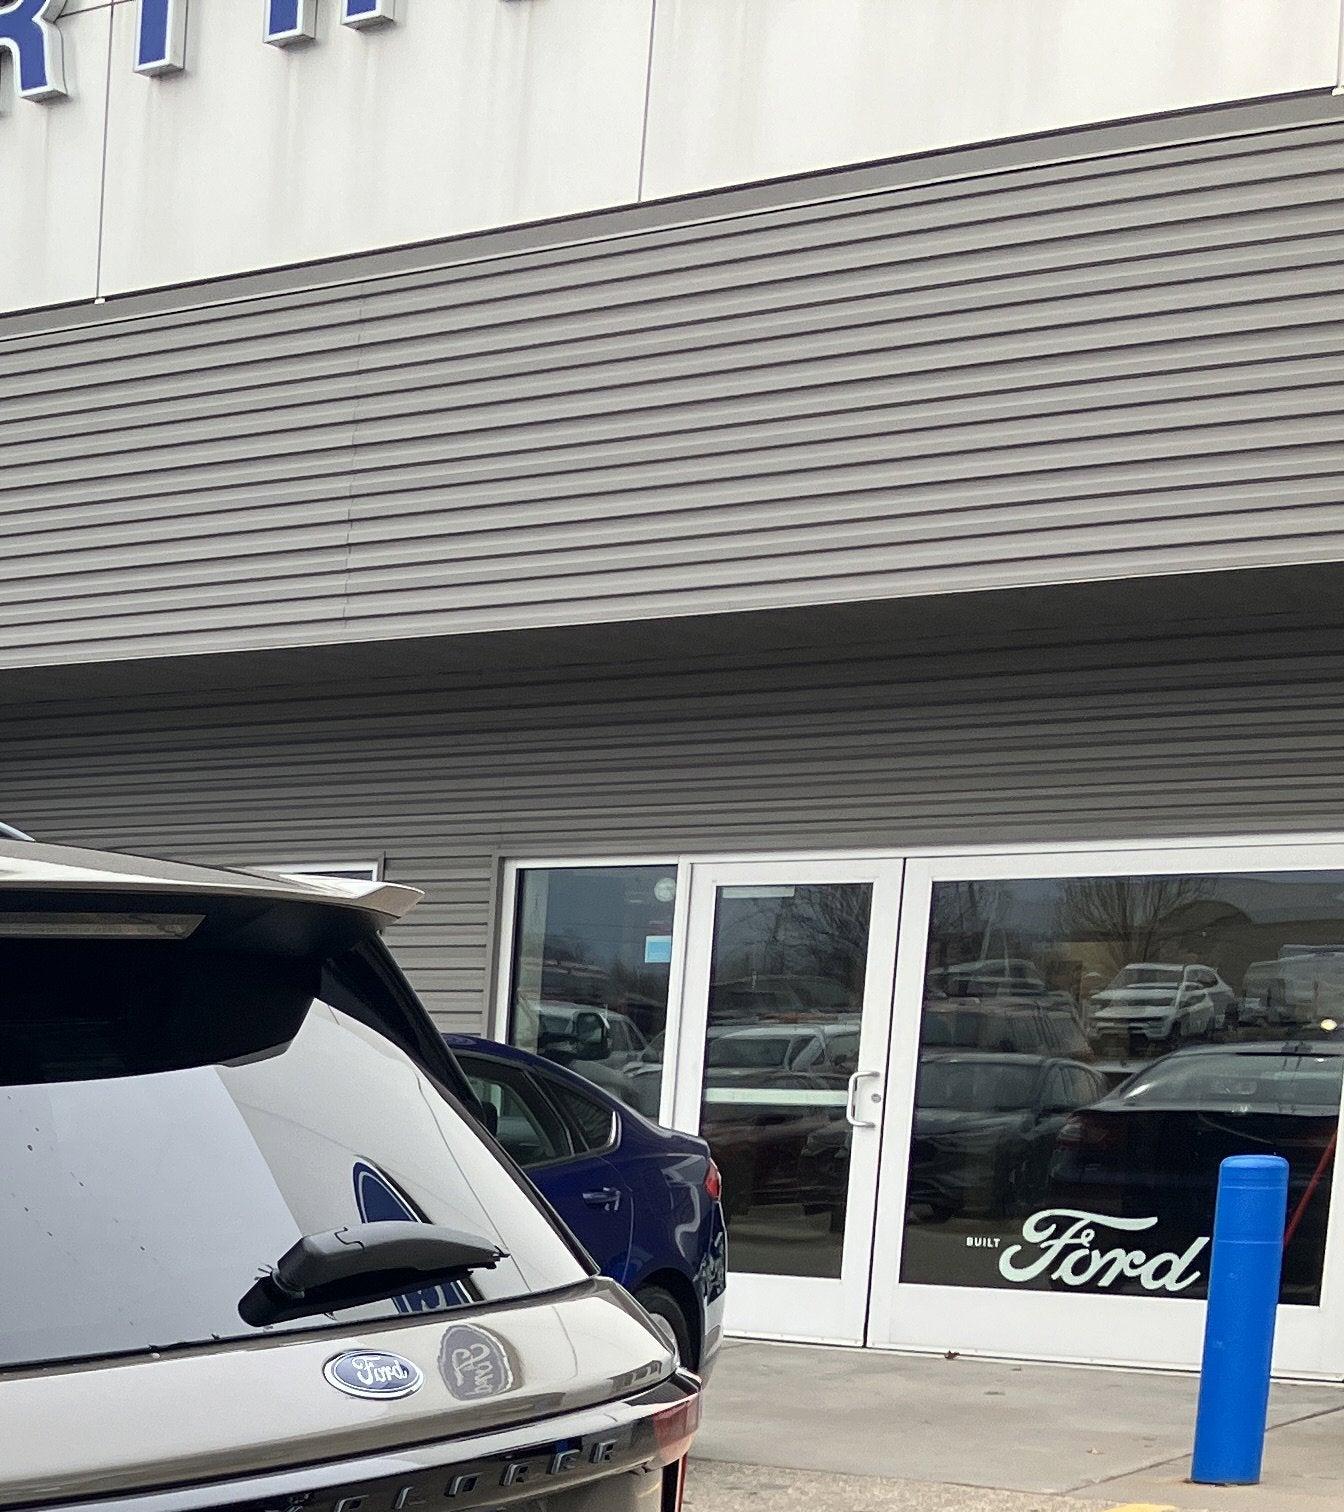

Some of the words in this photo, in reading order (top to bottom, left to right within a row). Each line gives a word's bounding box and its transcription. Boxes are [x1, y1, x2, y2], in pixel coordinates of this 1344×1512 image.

[966, 1236, 1001, 1248] BUILT
[999, 1208, 1210, 1292] Ford
[352, 1356, 408, 1386] Ford
